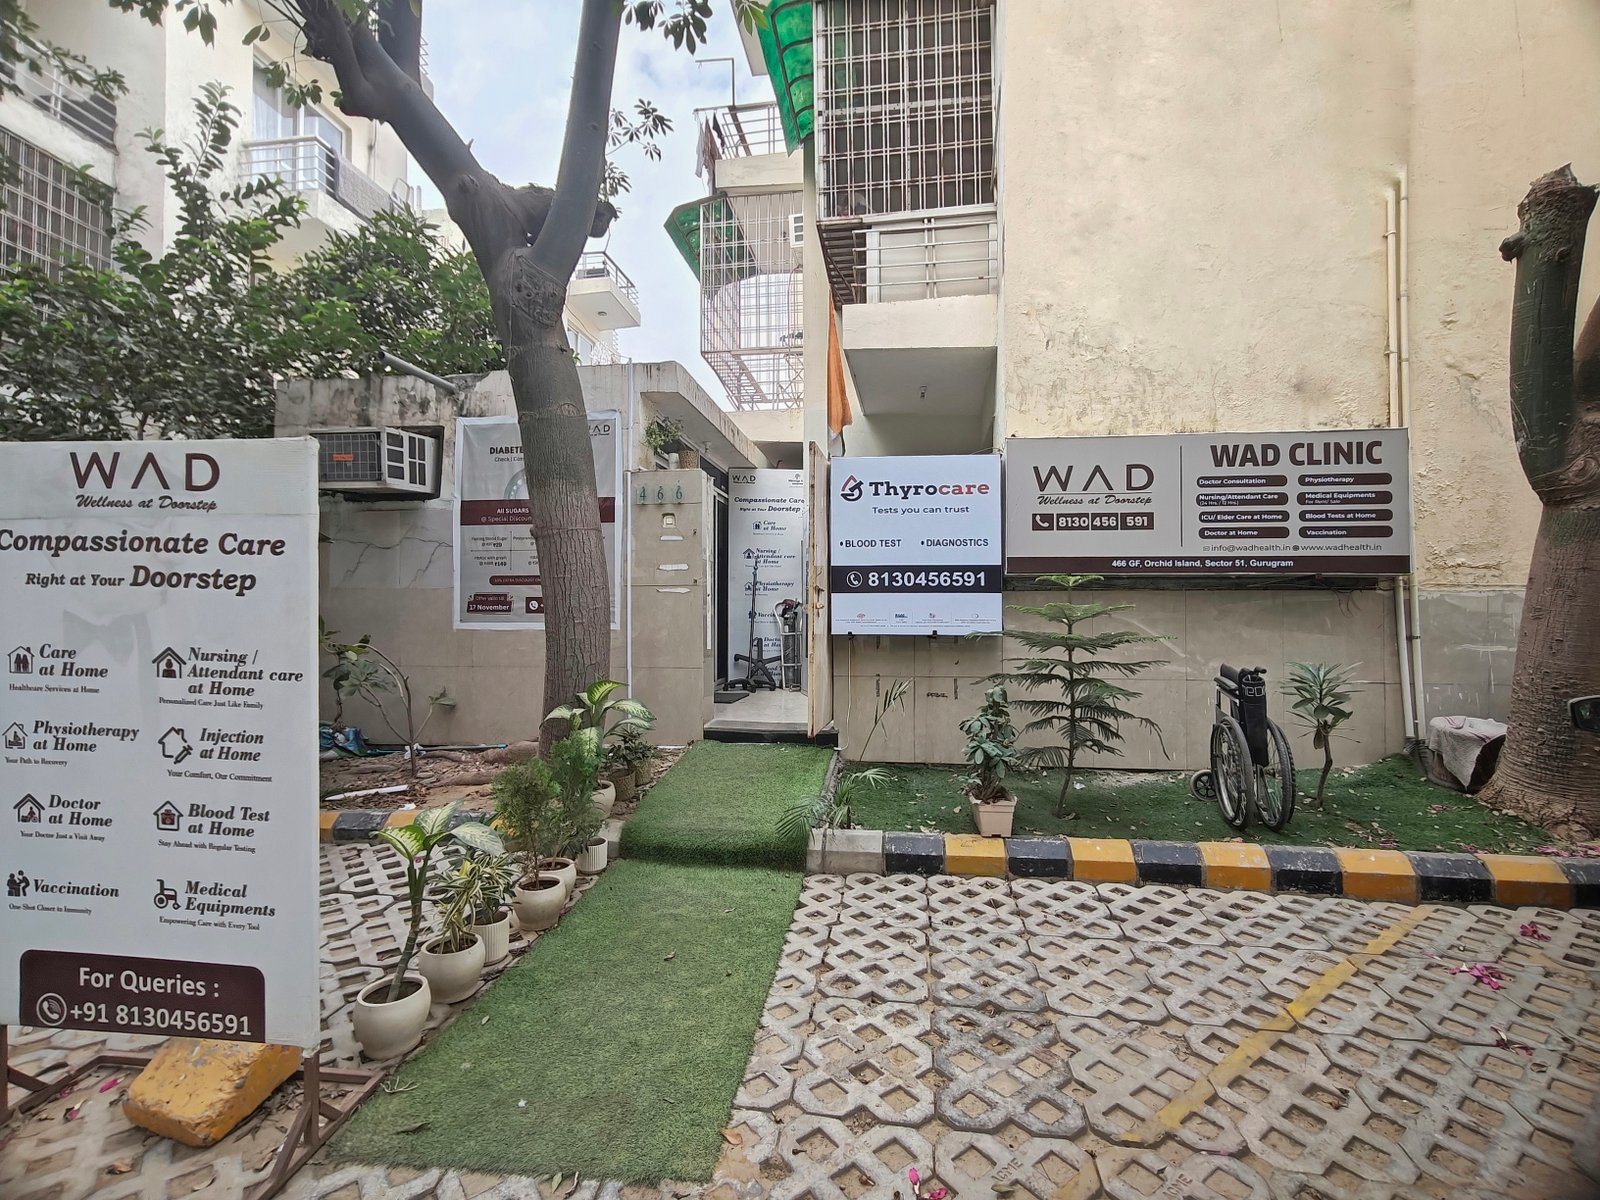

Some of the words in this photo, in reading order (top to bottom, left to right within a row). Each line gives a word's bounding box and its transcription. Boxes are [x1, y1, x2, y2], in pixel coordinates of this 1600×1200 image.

[589, 424, 610, 433] AD
[490, 446, 524, 455] DIABETE
[1210, 443, 1280, 468] WAD
[1289, 441, 1383, 466] CLINIC
[70, 452, 220, 492] WAD
[1033, 464, 1154, 492] WAD
[1305, 476, 1354, 484] Physiotherapy
[869, 481, 990, 500] Thyrocare
[1200, 493, 1262, 501] Nursing/Attendant
[75, 494, 133, 509] Wellness
[138, 497, 153, 509] at
[158, 495, 218, 513] Doorstep
[1036, 495, 1084, 506] Wellness
[1088, 496, 1100, 505] at
[1104, 495, 1152, 506] Doorstep
[510, 515, 532, 523] Discoun
[872, 506, 899, 515] Tests
[900, 507, 920, 516] you
[944, 506, 970, 514] trust
[1058, 517, 1089, 527] 8130
[1092, 516, 1117, 527] 456
[1126, 516, 1148, 527] 591
[0, 529, 209, 558] Compassionate
[218, 532, 286, 556] Care
[845, 539, 877, 548] BLOOD
[879, 539, 902, 547] TEST
[926, 538, 989, 547] DIAGNOSTICS
[1211, 544, 1291, 552] info@wadhealth.in
[1128, 560, 1142, 568] GF,
[1144, 559, 1173, 567] Orchid
[1175, 559, 1203, 568] Island,
[1205, 559, 1232, 567] Sector
[1235, 559, 1248, 568] 51,
[1250, 559, 1294, 568] Gurugram
[25, 573, 66, 588] Right
[70, 574, 86, 586] at
[91, 574, 125, 587] Your
[129, 565, 257, 597] Doorstep
[868, 571, 986, 587] 8130456591
[39, 643, 77, 659] Care
[188, 646, 249, 667] Nursing
[39, 664, 55, 676] at
[61, 661, 109, 678] Home
[187, 664, 264, 680] Attendant
[269, 672, 304, 682] care
[9, 684, 43, 692] Healthcare
[44, 684, 71, 693] Services
[81, 686, 100, 694] Home
[188, 683, 204, 694] at
[209, 681, 255, 697] Home
[198, 698, 212, 706] Care
[213, 699, 226, 707] Just
[227, 700, 241, 708] Like
[243, 701, 263, 710] Family
[33, 720, 140, 742] Physiotherapy
[200, 728, 264, 745] Injection
[33, 739, 47, 750] at
[53, 736, 97, 752] Home
[200, 747, 215, 759] at
[217, 746, 262, 762] Home
[167, 769, 183, 777] Your
[184, 770, 213, 780] Comfort,
[215, 772, 228, 780] Our
[229, 773, 273, 782] Commitment
[48, 794, 101, 810] Doctor
[48, 814, 63, 824] at
[68, 811, 113, 827] Home
[188, 803, 235, 820] Blood
[240, 807, 270, 822] Test
[20, 830, 33, 838] Your
[35, 831, 54, 839] Doctor
[56, 832, 68, 840] Just
[89, 834, 105, 842] Away
[188, 822, 203, 834] at
[208, 821, 255, 838] Home
[158, 839, 172, 848] Stay
[173, 840, 192, 849] Ahead
[208, 843, 232, 852] Regular
[234, 844, 256, 854] Testing
[33, 879, 119, 898] Vaccination
[185, 880, 247, 898] Medical
[22, 903, 35, 911] Shot
[37, 904, 55, 912] Closer
[185, 897, 276, 917] Equipments
[159, 916, 196, 926] Empowering
[198, 919, 212, 927] Care
[214, 920, 227, 928] with
[228, 921, 246, 930] Every
[247, 922, 260, 931] Tool
[79, 967, 114, 988] For
[120, 969, 206, 997] Queries
[70, 1002, 109, 1023] +91
[116, 1004, 251, 1036] 8130456591
